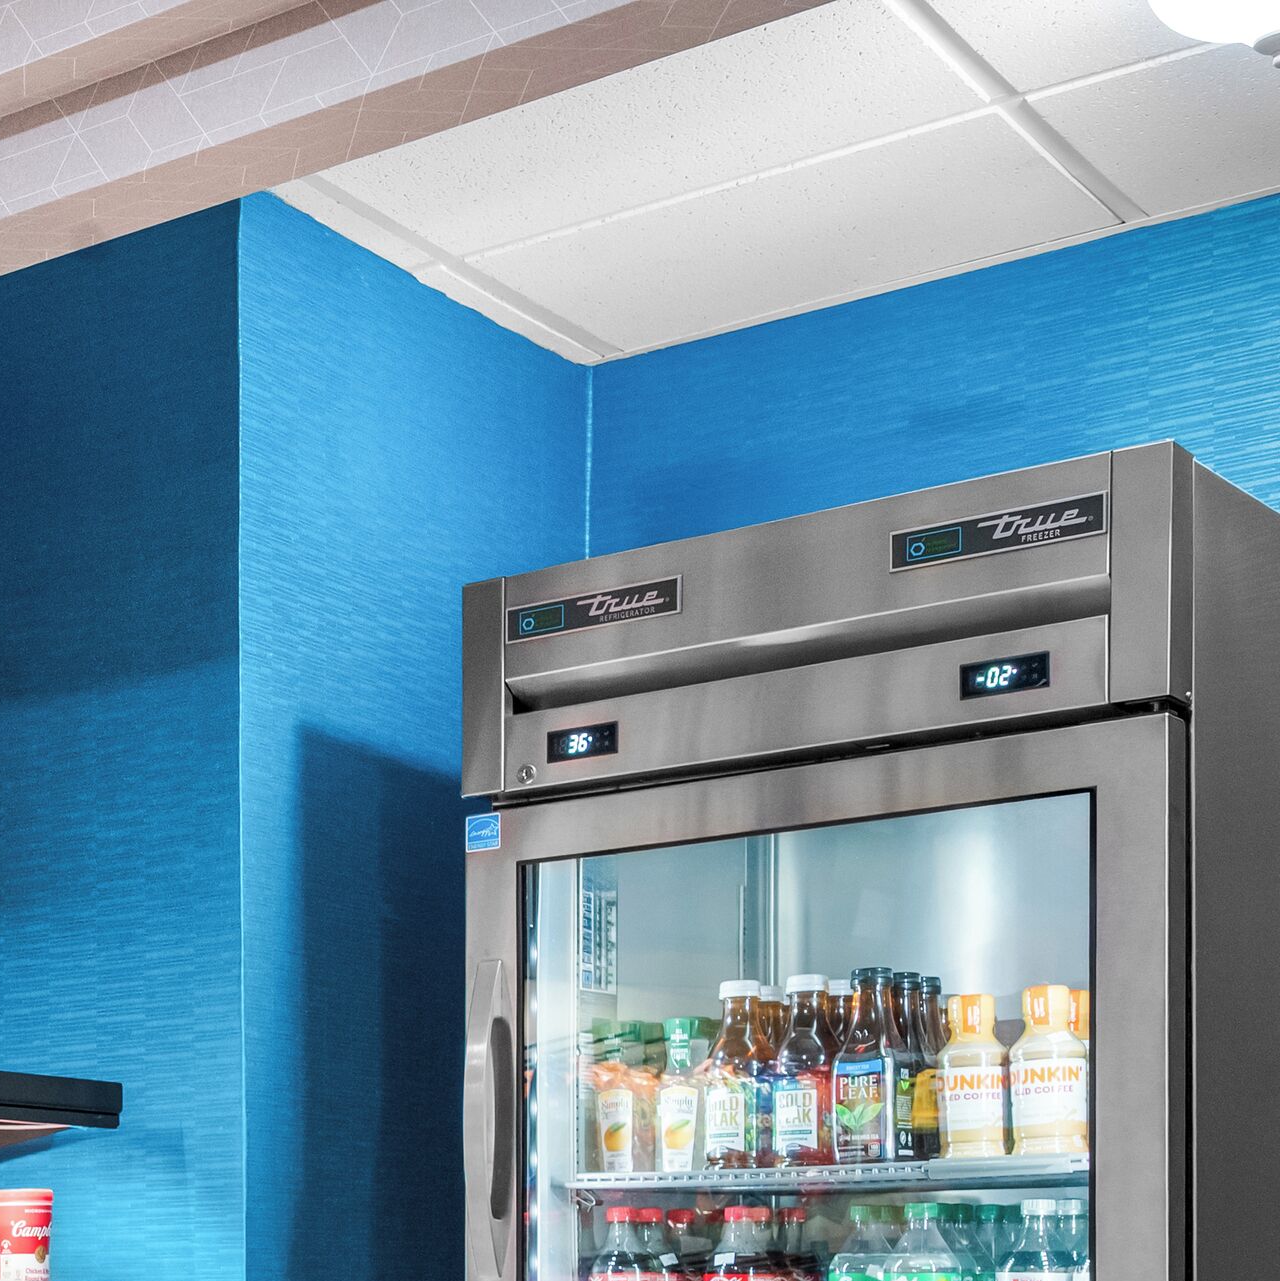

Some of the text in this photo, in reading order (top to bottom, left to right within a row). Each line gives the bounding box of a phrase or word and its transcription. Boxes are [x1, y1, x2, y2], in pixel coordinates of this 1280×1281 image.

[978, 509, 1087, 539] true
[1022, 530, 1060, 542] FREEZER
[576, 591, 664, 616] true
[600, 607, 655, 622] REFRIGERATOR
[840, 1074, 877, 1088] PURE
[840, 1086, 878, 1100] LEAF
